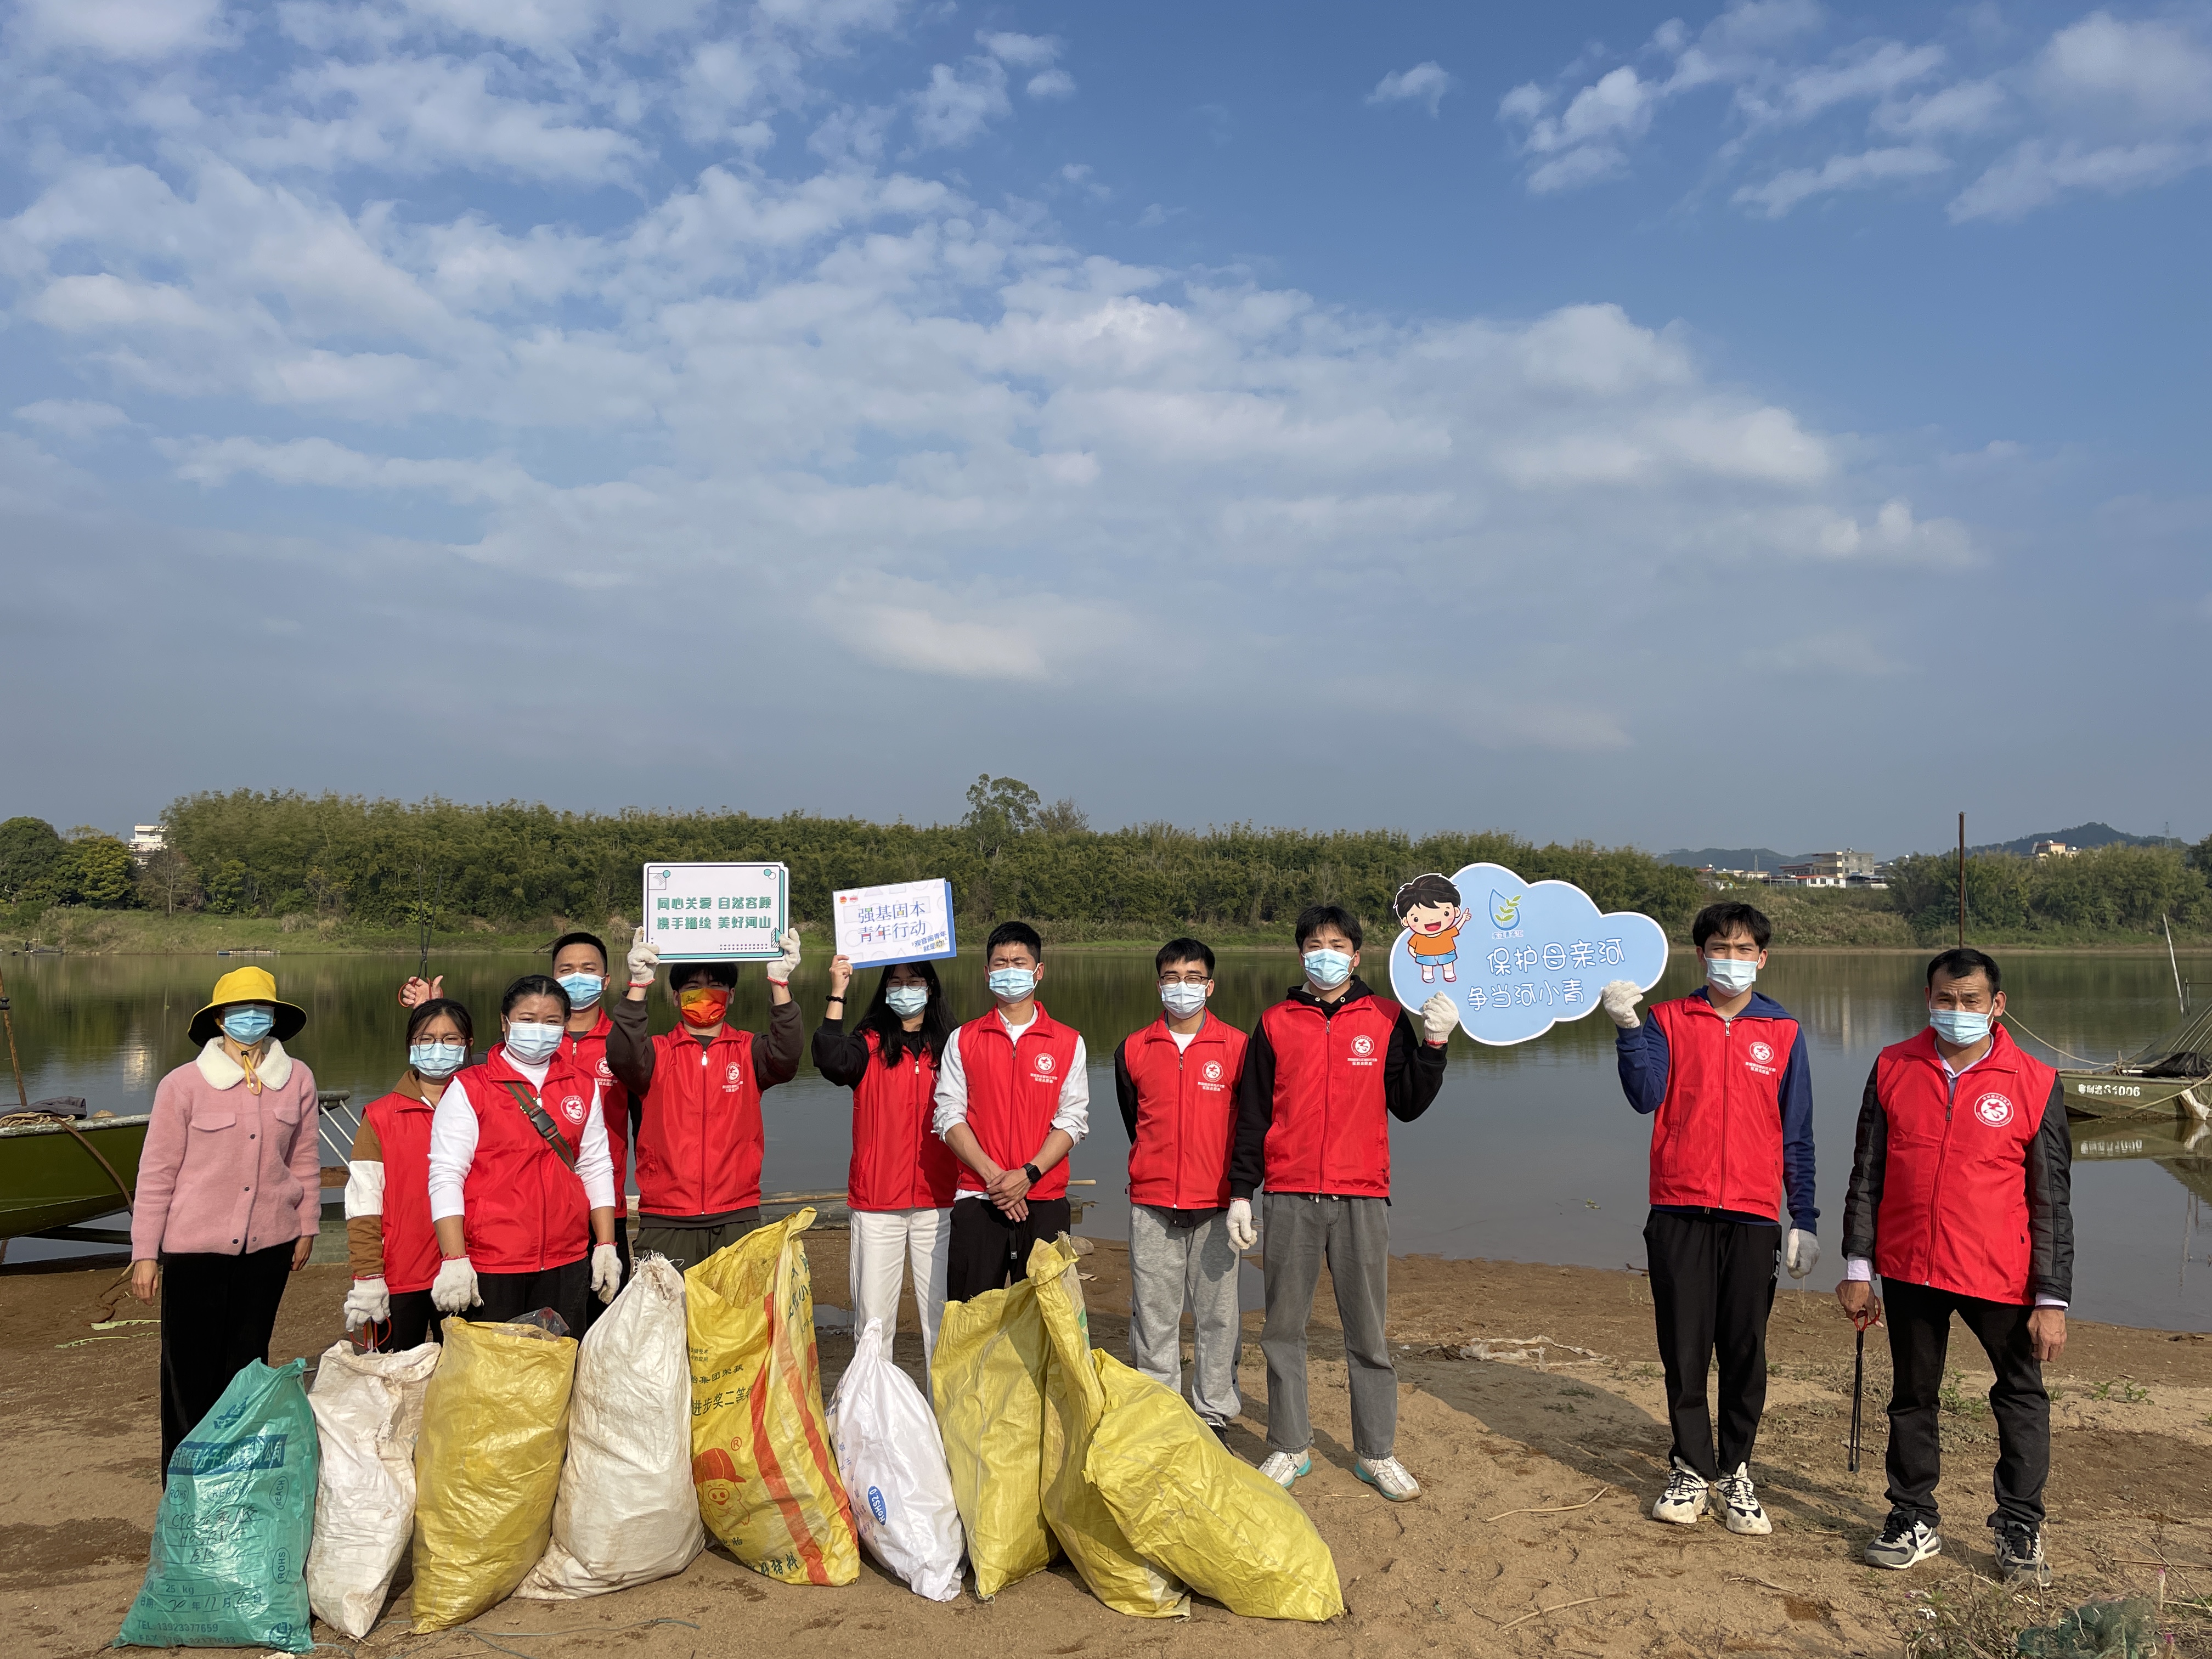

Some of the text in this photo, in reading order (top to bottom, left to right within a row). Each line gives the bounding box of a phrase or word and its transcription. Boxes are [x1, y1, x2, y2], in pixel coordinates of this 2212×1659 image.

[657, 896, 771, 910] 同心关爱 自然容颜
[858, 901, 926, 924] 强基固本
[657, 916, 771, 930] 携手描绘 美好河山
[858, 919, 926, 943] 青年行动
[1487, 937, 1626, 976] 保护母亲河
[1467, 978, 1584, 1012] 争当河小青
[170, 1488, 187, 1499] ROHS
[275, 1480, 286, 1506] REACH
[278, 1551, 286, 1579] ROHS
[166, 1584, 194, 1594] 25 kg
